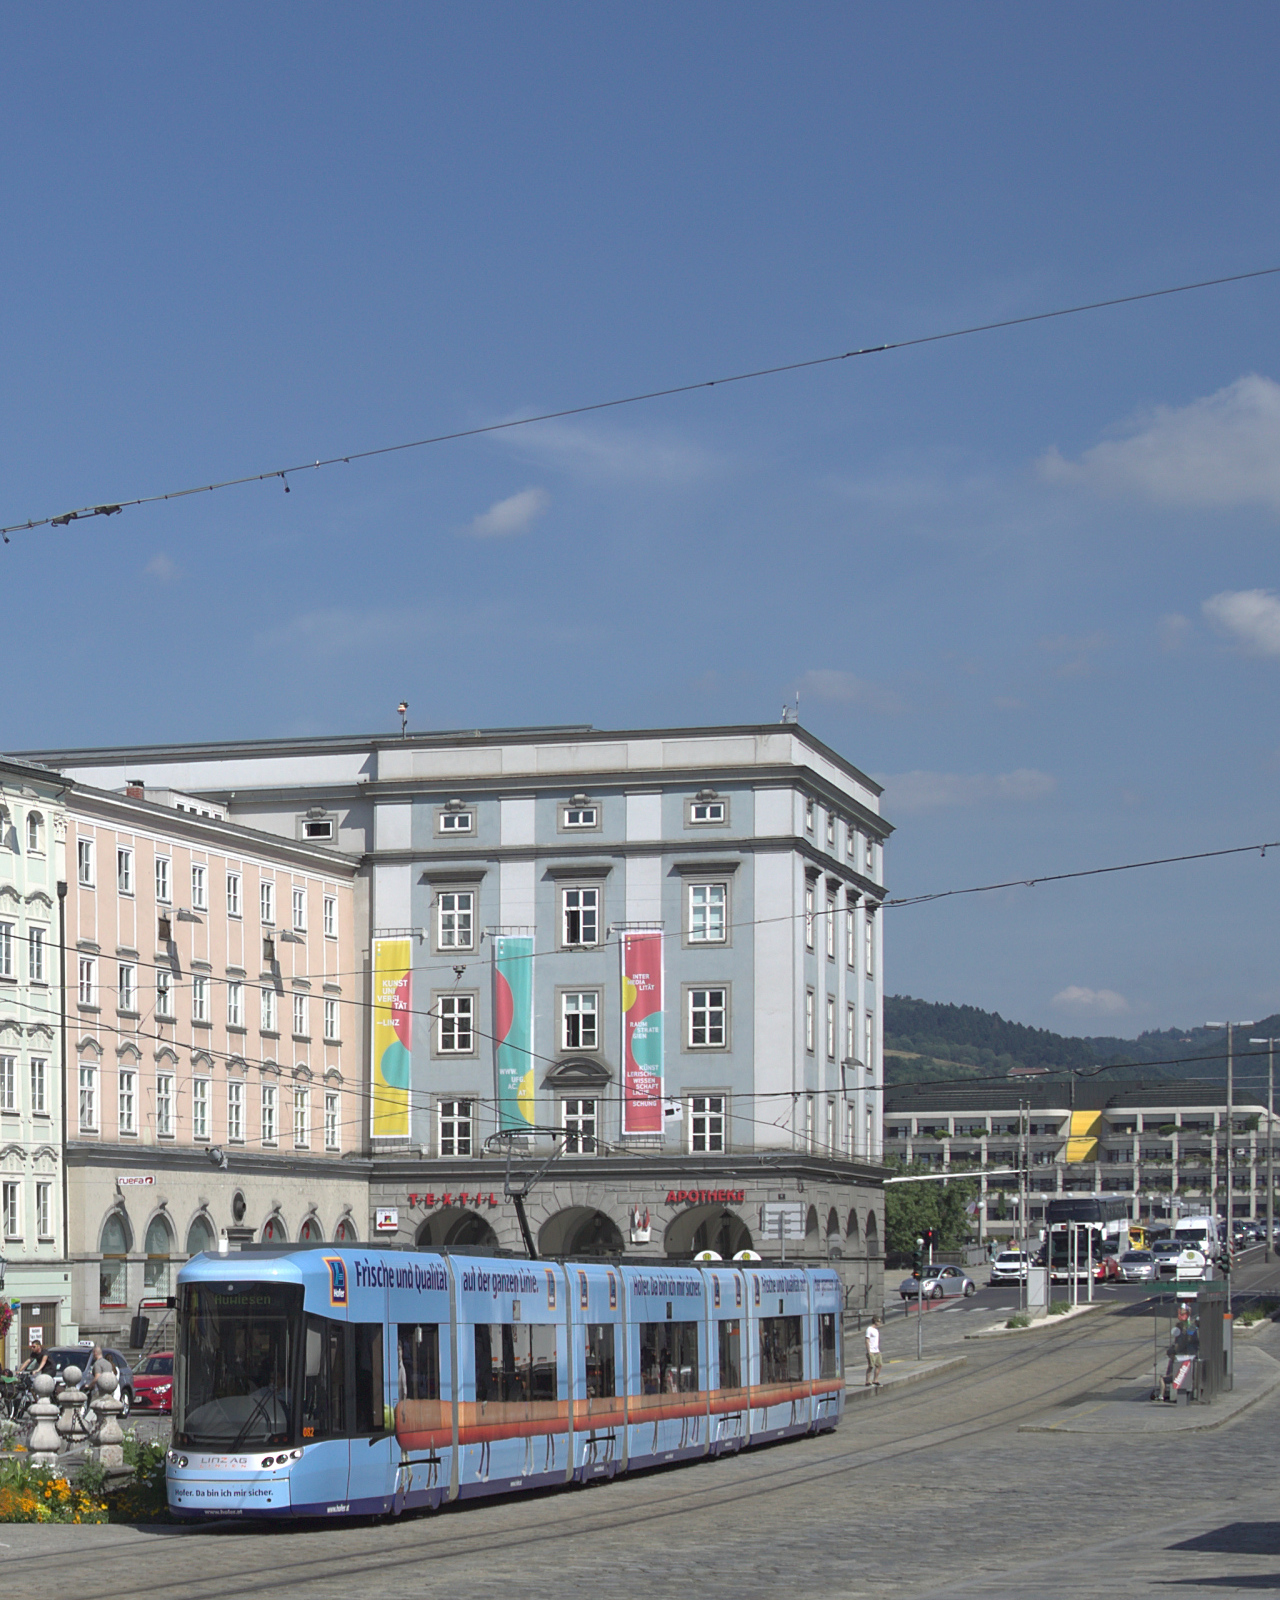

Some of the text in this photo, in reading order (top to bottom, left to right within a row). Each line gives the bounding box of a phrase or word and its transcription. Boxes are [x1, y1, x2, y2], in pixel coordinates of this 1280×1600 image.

[666, 1189, 745, 1202] APOTHEKE
[354, 1257, 395, 1288] Frische
[396, 1262, 414, 1289] und
[415, 1262, 448, 1294] Qualität
[463, 1265, 476, 1292] auf
[477, 1266, 490, 1292] der
[492, 1272, 519, 1299] ganzen
[302, 1427, 314, 1437] 082
[174, 1489, 194, 1497] Hofer.
[207, 1489, 219, 1497] bin
[220, 1489, 232, 1497] ich
[233, 1489, 247, 1497] mir
[248, 1488, 273, 1496] sicher.
